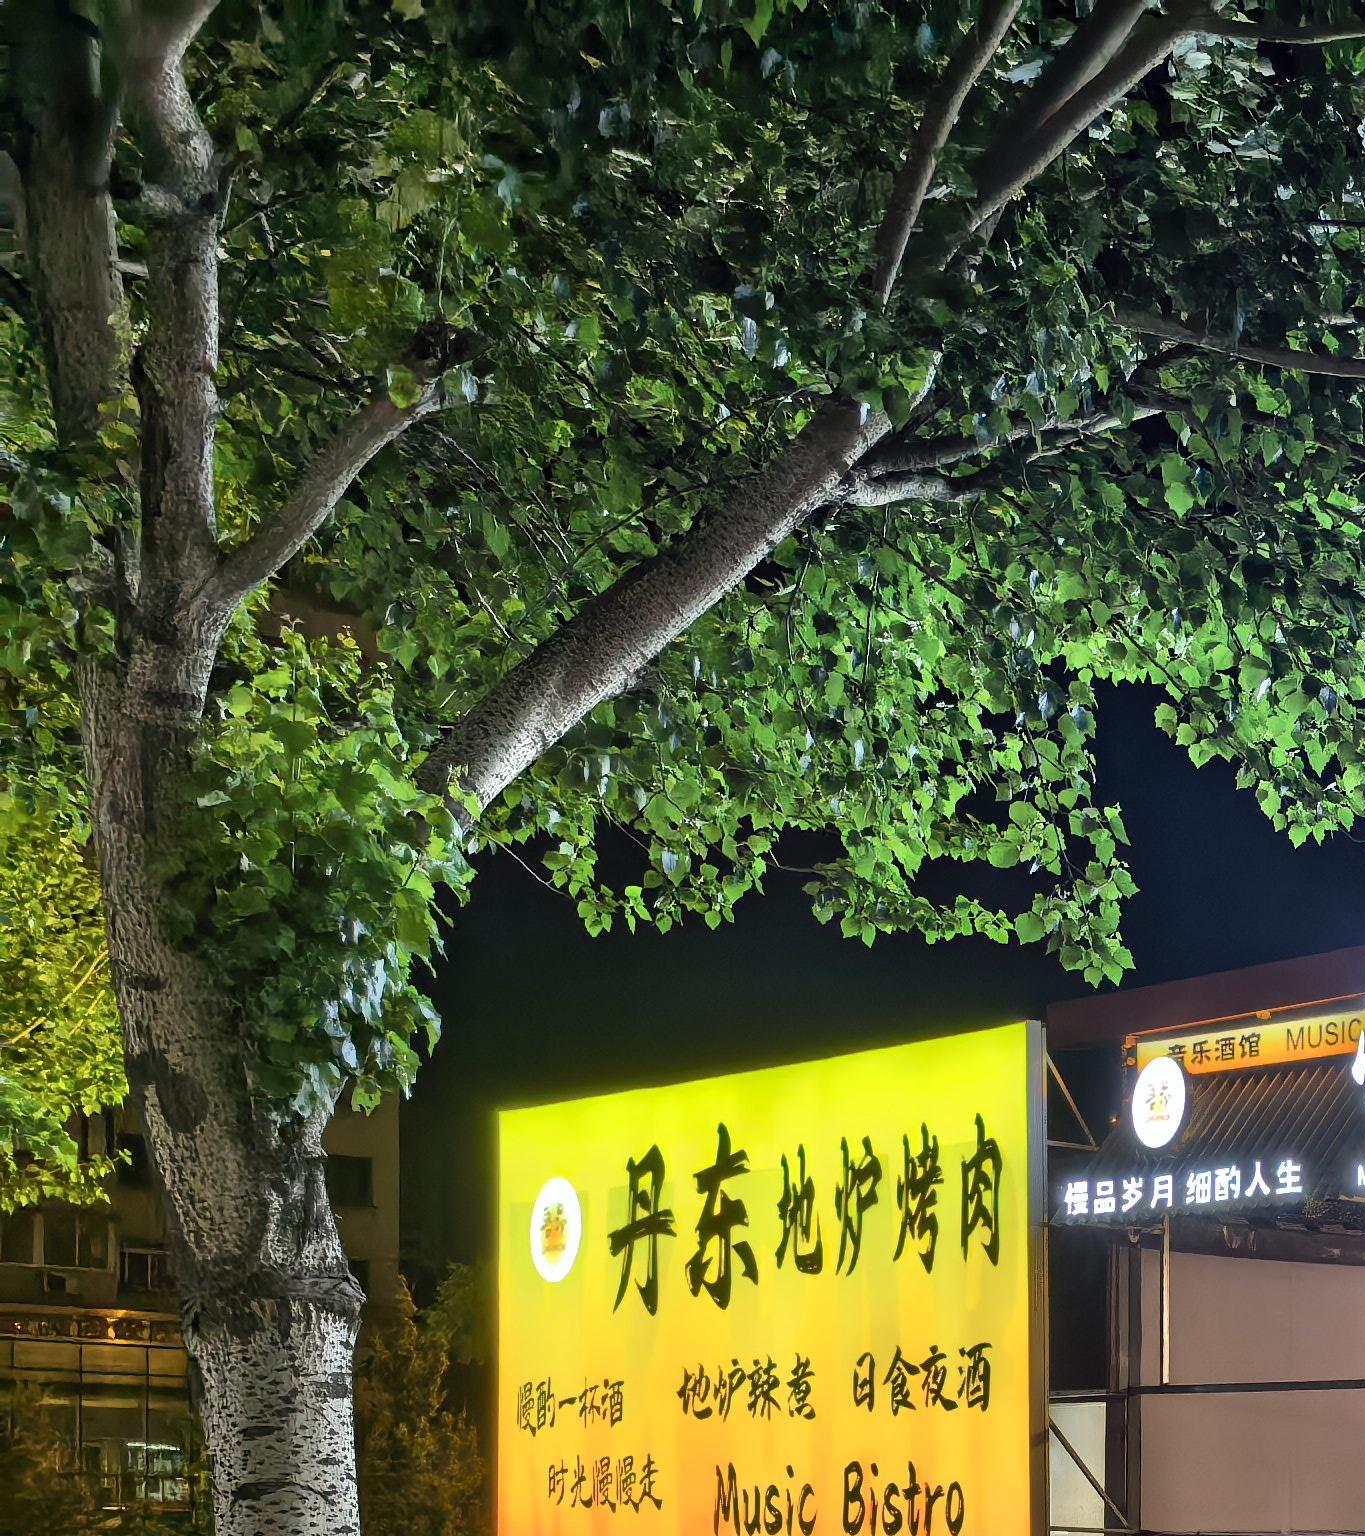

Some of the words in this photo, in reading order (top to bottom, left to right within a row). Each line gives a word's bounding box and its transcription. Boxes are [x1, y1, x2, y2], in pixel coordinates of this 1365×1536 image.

[1167, 1032, 1262, 1068] 音乐酒馆
[608, 1112, 1003, 1316] 丹东地炉烤肉
[1064, 1175, 1174, 1218] 慢品岁月
[1186, 1158, 1303, 1204] 细酌人生
[677, 1352, 817, 1421] 地炉辣煮
[852, 1342, 993, 1417] 日食夜酒
[547, 1453, 663, 1514] 时光慢慢走
